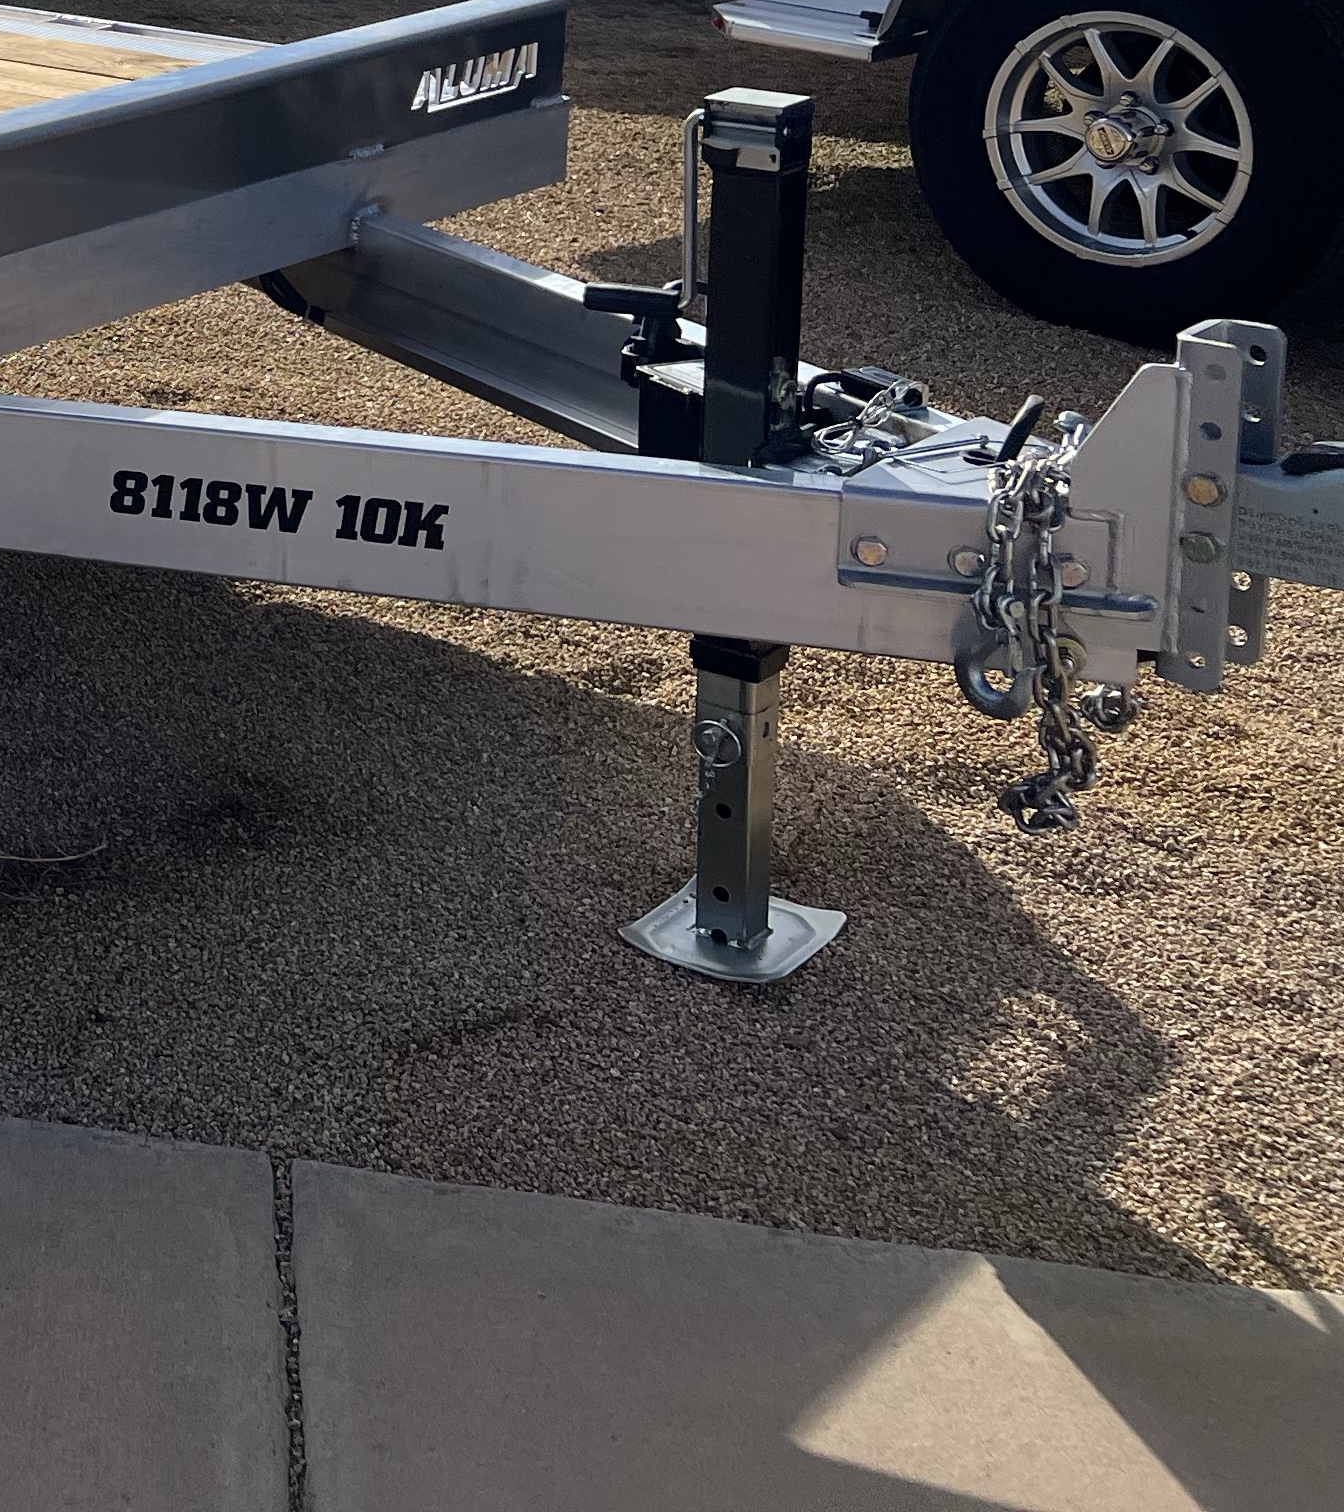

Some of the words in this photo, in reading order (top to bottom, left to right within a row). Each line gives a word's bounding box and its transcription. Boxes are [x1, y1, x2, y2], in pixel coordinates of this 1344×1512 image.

[410, 41, 539, 114] ALUMA
[108, 469, 314, 535] 8118W
[334, 493, 451, 551] 10K
